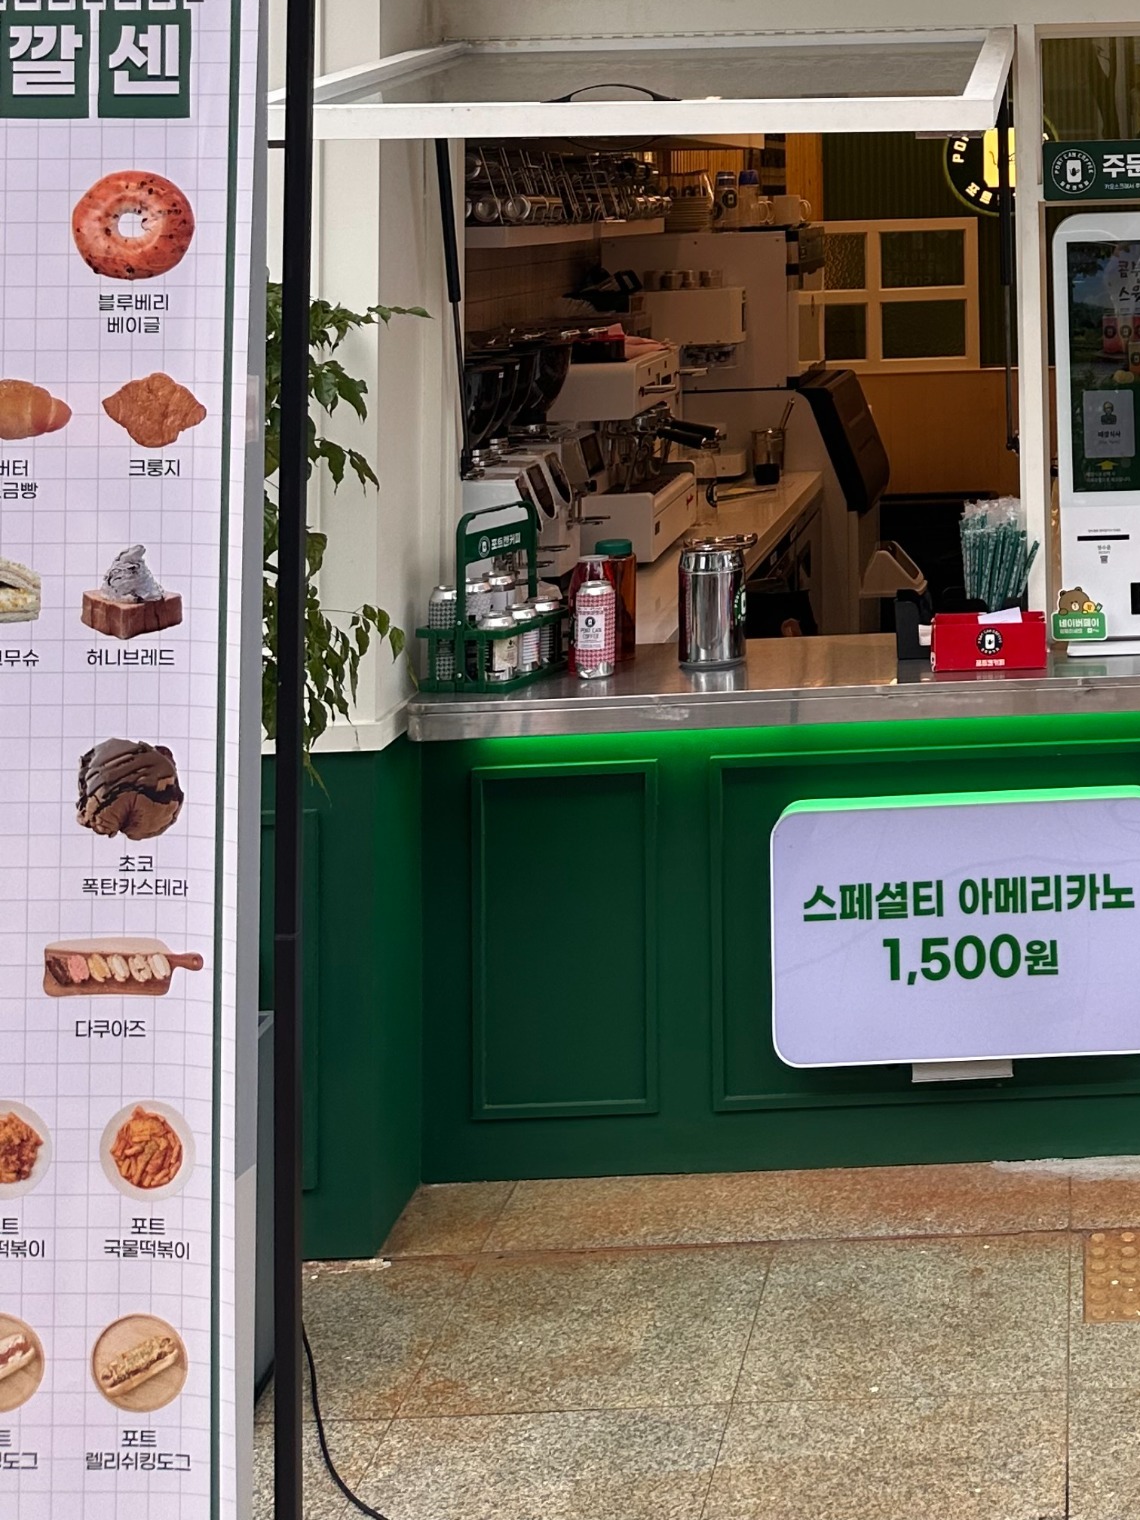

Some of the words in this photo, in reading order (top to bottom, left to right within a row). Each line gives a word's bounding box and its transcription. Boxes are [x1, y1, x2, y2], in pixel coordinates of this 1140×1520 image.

[98, 294, 169, 313] 블루베리
[107, 316, 161, 334] 베이글
[129, 459, 181, 477] 크룽지
[0, 482, 38, 500] 금빵
[0, 648, 40, 667] 무슈
[87, 648, 175, 667] 허니브레드
[119, 855, 154, 874] 초코
[82, 877, 188, 898] 폭탄카스테라
[803, 880, 944, 922] 스페셜티
[959, 873, 1135, 916] 아메리카노
[882, 934, 1059, 986] 1,500원
[75, 1020, 146, 1039] 다쿠아즈
[131, 1218, 165, 1235] 포트
[104, 1239, 190, 1260] 국물떡볶이
[122, 1430, 157, 1447] 포트
[0, 1452, 38, 1470] 도그
[86, 1452, 191, 1471] 렐리쉬킹도그
